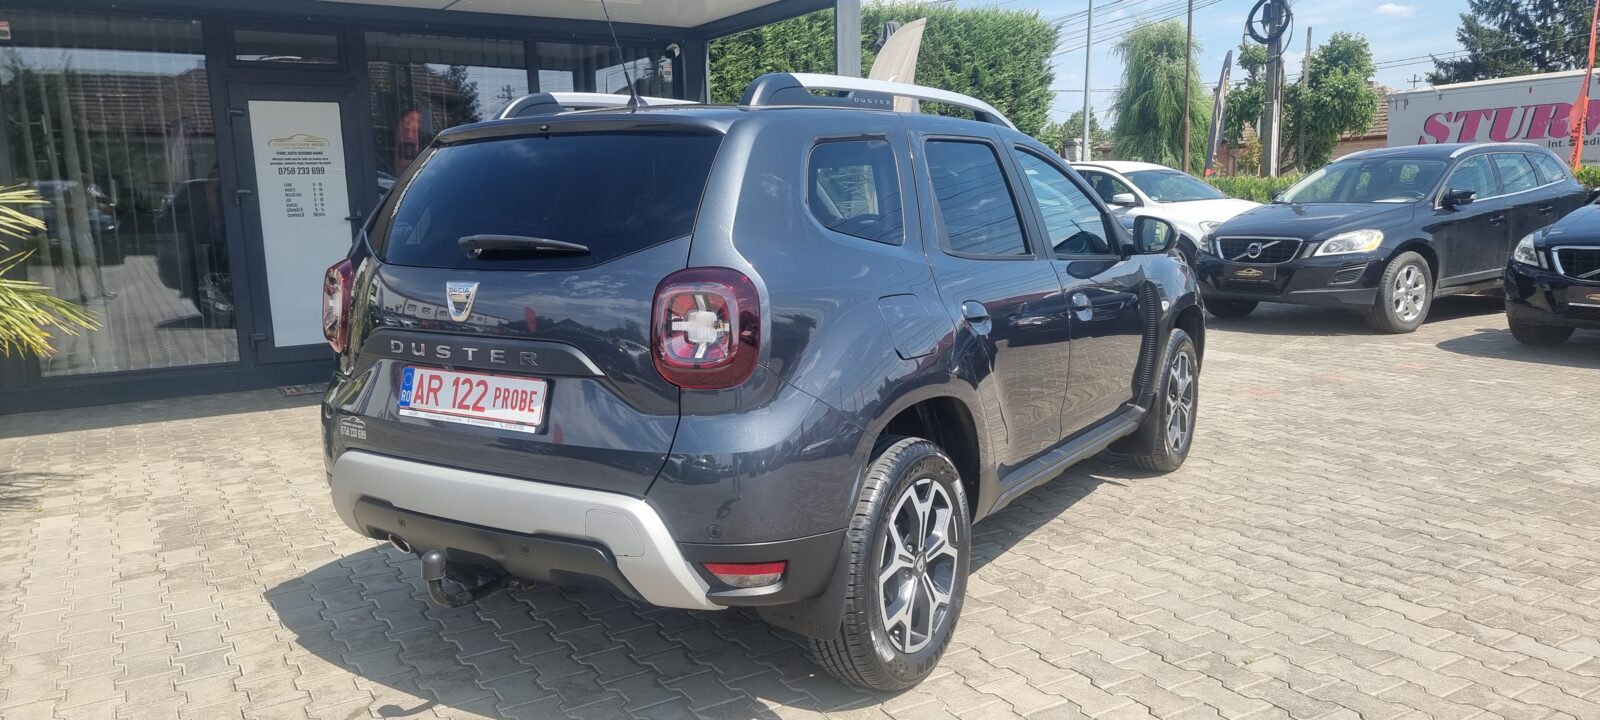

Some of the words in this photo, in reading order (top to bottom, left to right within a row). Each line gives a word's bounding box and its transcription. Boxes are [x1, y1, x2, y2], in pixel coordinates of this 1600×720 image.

[854, 97, 891, 105] DUSTER
[297, 166, 310, 175] 233
[390, 339, 539, 367] DUSTER
[400, 390, 411, 402] RO
[413, 373, 443, 406] AR
[452, 376, 489, 412] 122
[493, 386, 538, 413] PROBE
